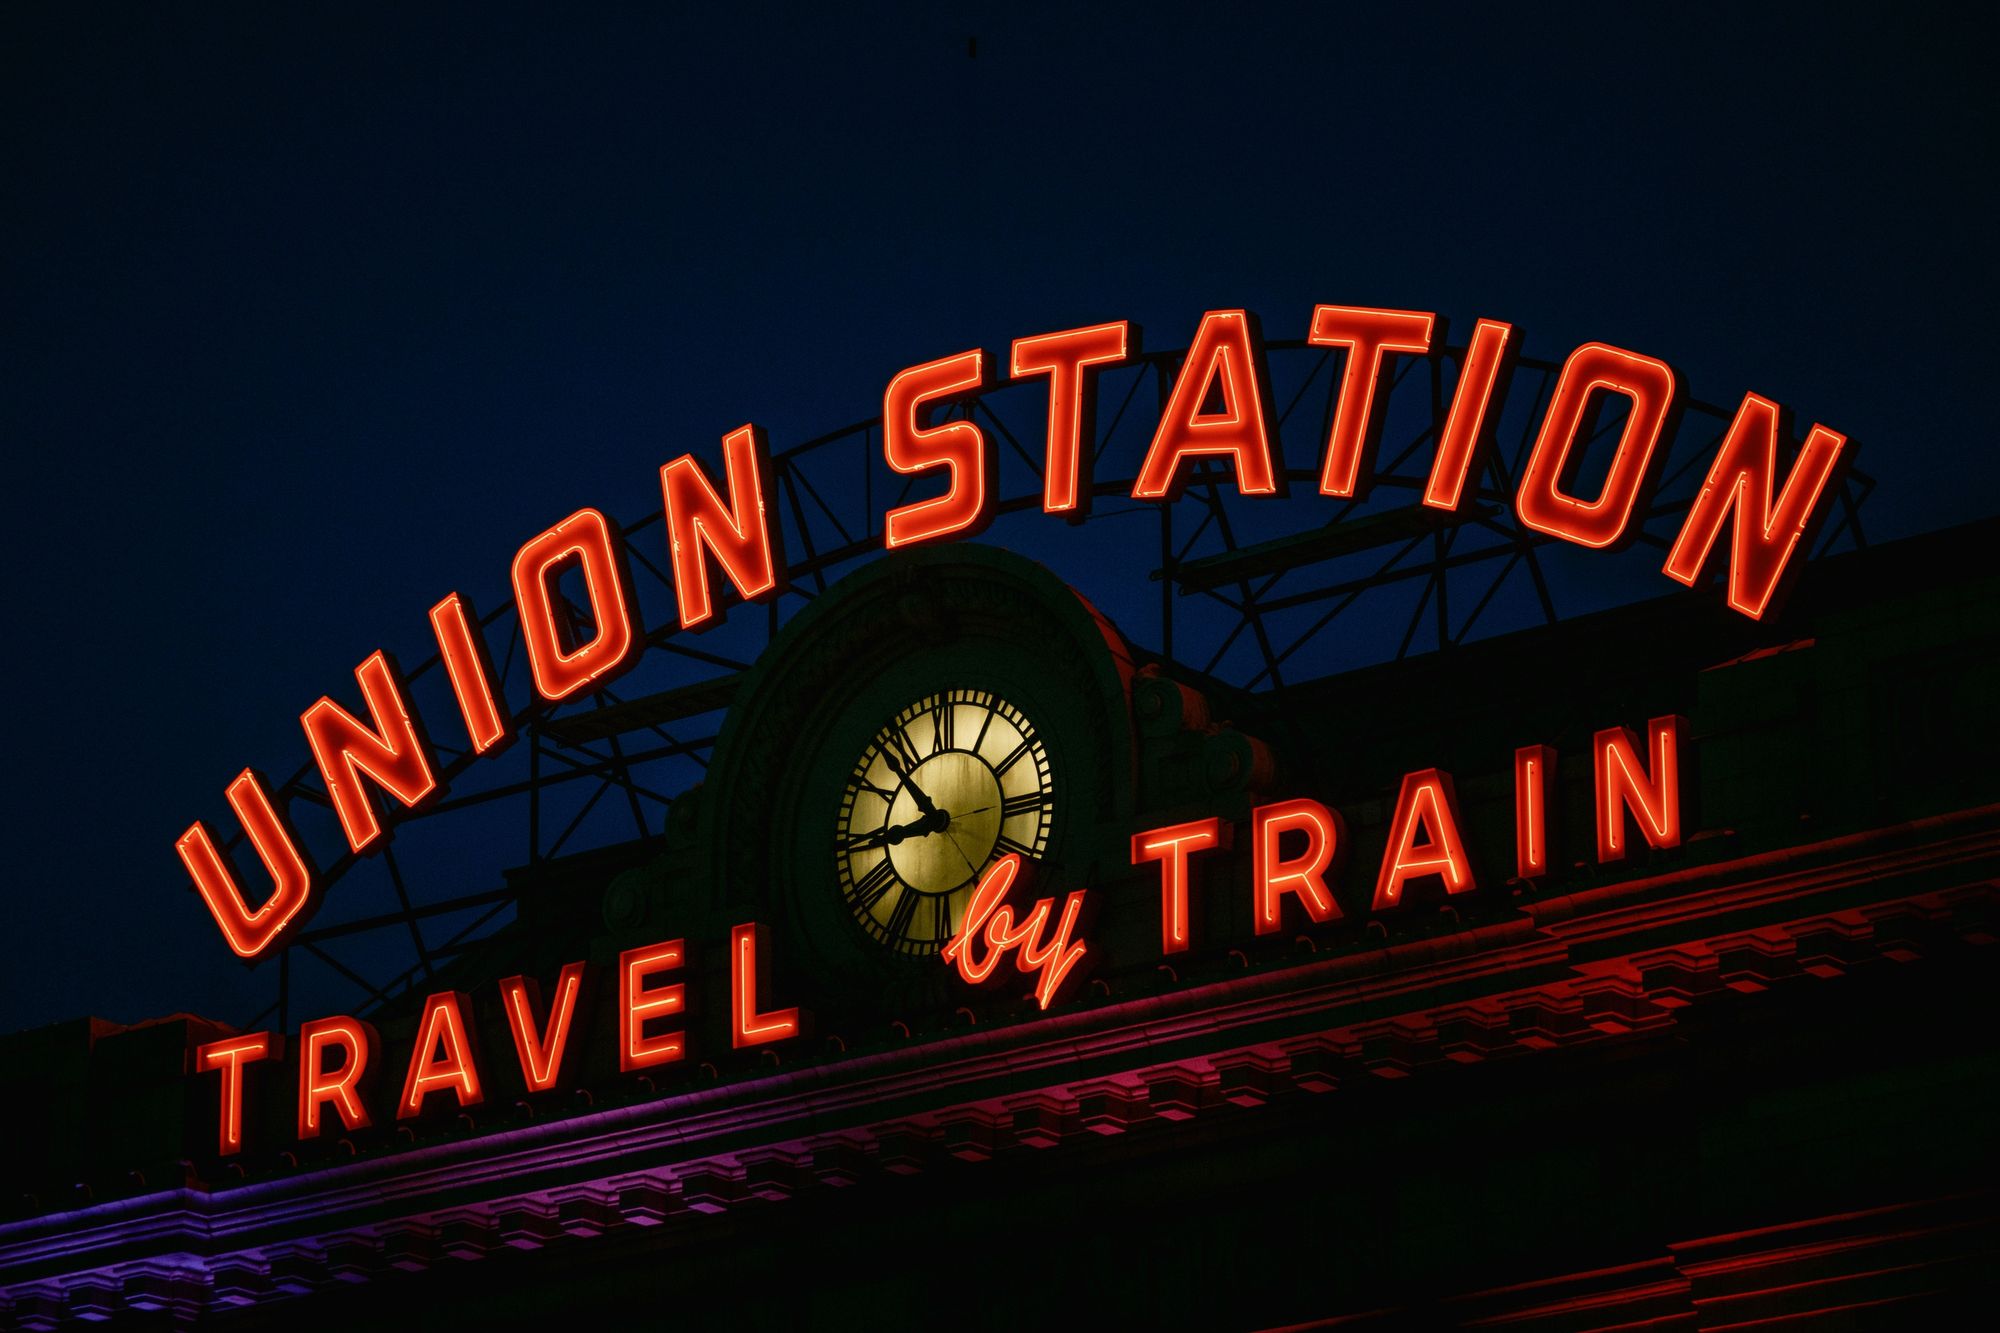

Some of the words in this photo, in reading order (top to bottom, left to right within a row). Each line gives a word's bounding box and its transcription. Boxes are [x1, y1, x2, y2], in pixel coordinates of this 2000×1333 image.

[175, 423, 776, 959] UNION
[884, 303, 1847, 621] STATION
[931, 703, 954, 754] XII
[993, 740, 1032, 778] II
[1003, 790, 1042, 819] III
[196, 922, 799, 1156] TRAVEL
[941, 853, 1087, 1011] by
[1131, 713, 1679, 955] TRAIN
